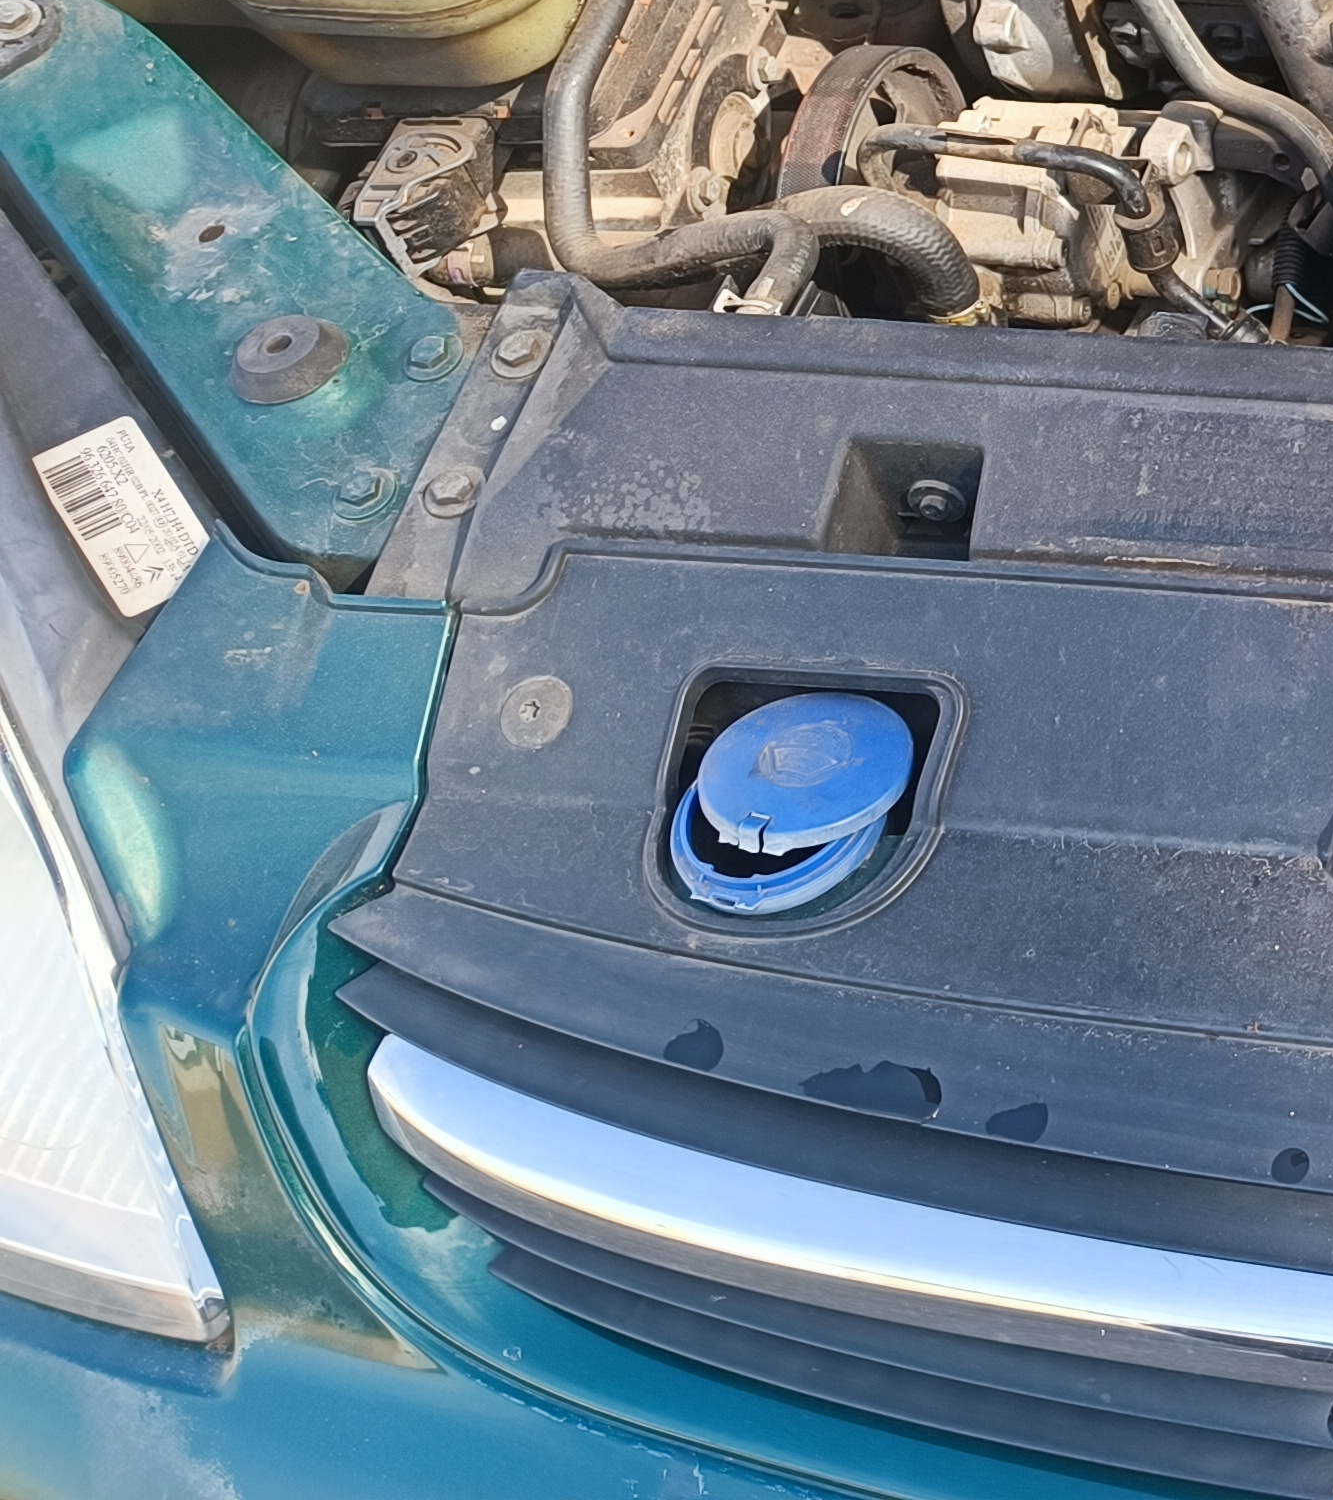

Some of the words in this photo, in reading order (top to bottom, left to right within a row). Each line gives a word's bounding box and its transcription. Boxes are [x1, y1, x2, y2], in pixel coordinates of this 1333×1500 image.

[79, 447, 96, 462] 96
[87, 460, 107, 480] 326
[99, 480, 119, 497] 647
[159, 502, 176, 519] H7
[168, 516, 185, 533] H4
[177, 531, 199, 556] DTD
